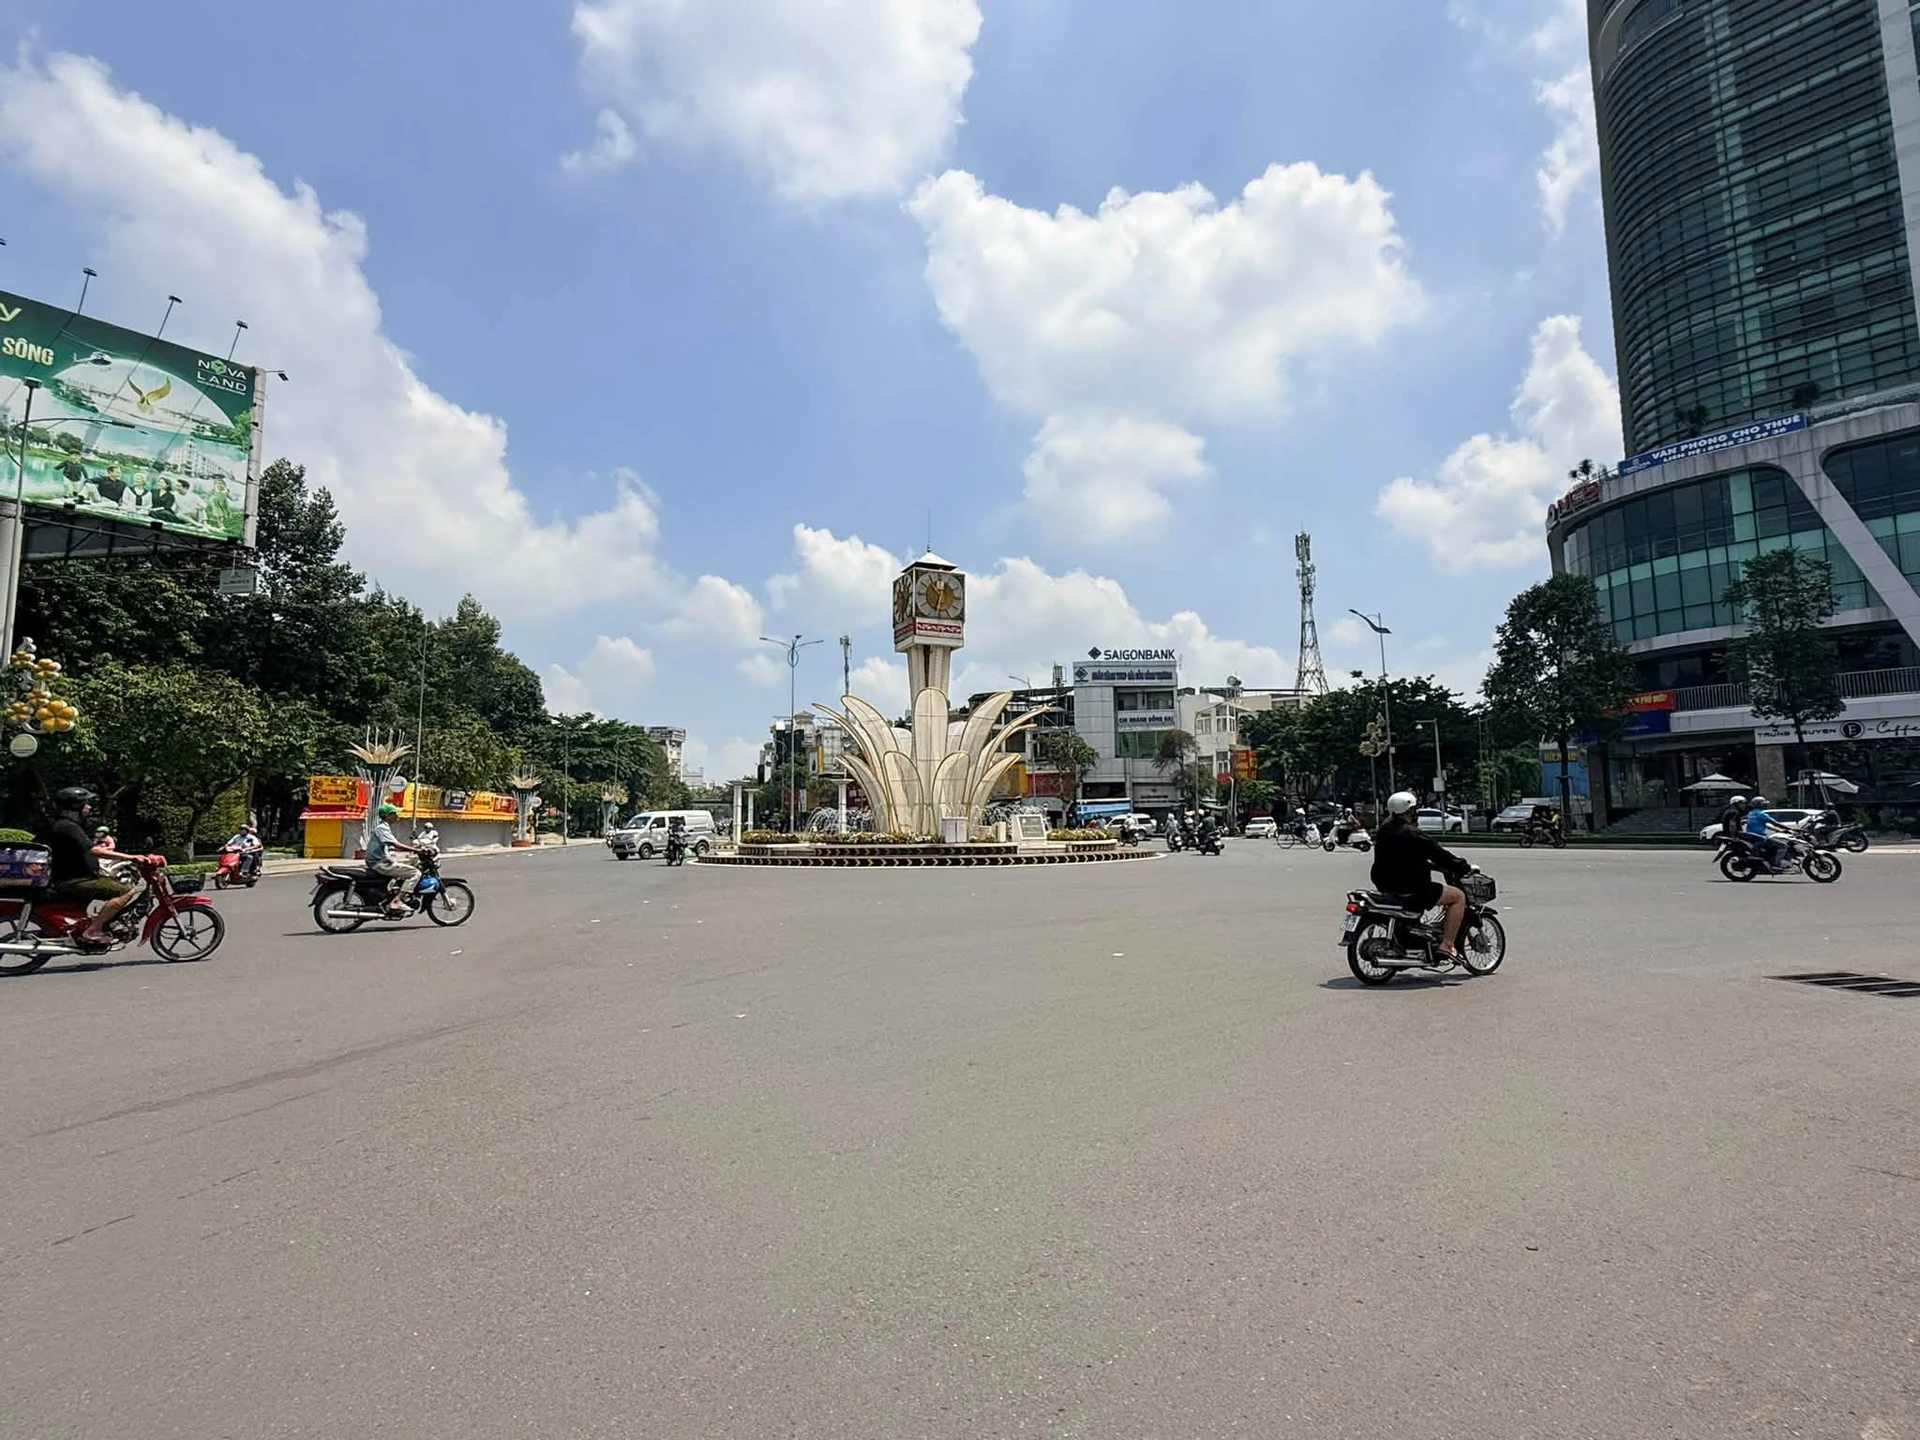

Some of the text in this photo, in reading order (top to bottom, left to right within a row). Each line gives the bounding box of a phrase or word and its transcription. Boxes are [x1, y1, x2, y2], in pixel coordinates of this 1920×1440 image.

[2, 337, 55, 366] SÔNG
[198, 359, 247, 380] NOVA
[197, 371, 247, 392] LAND
[1732, 425, 1760, 438] CHO
[1104, 649, 1175, 660] SAIGONBANK
